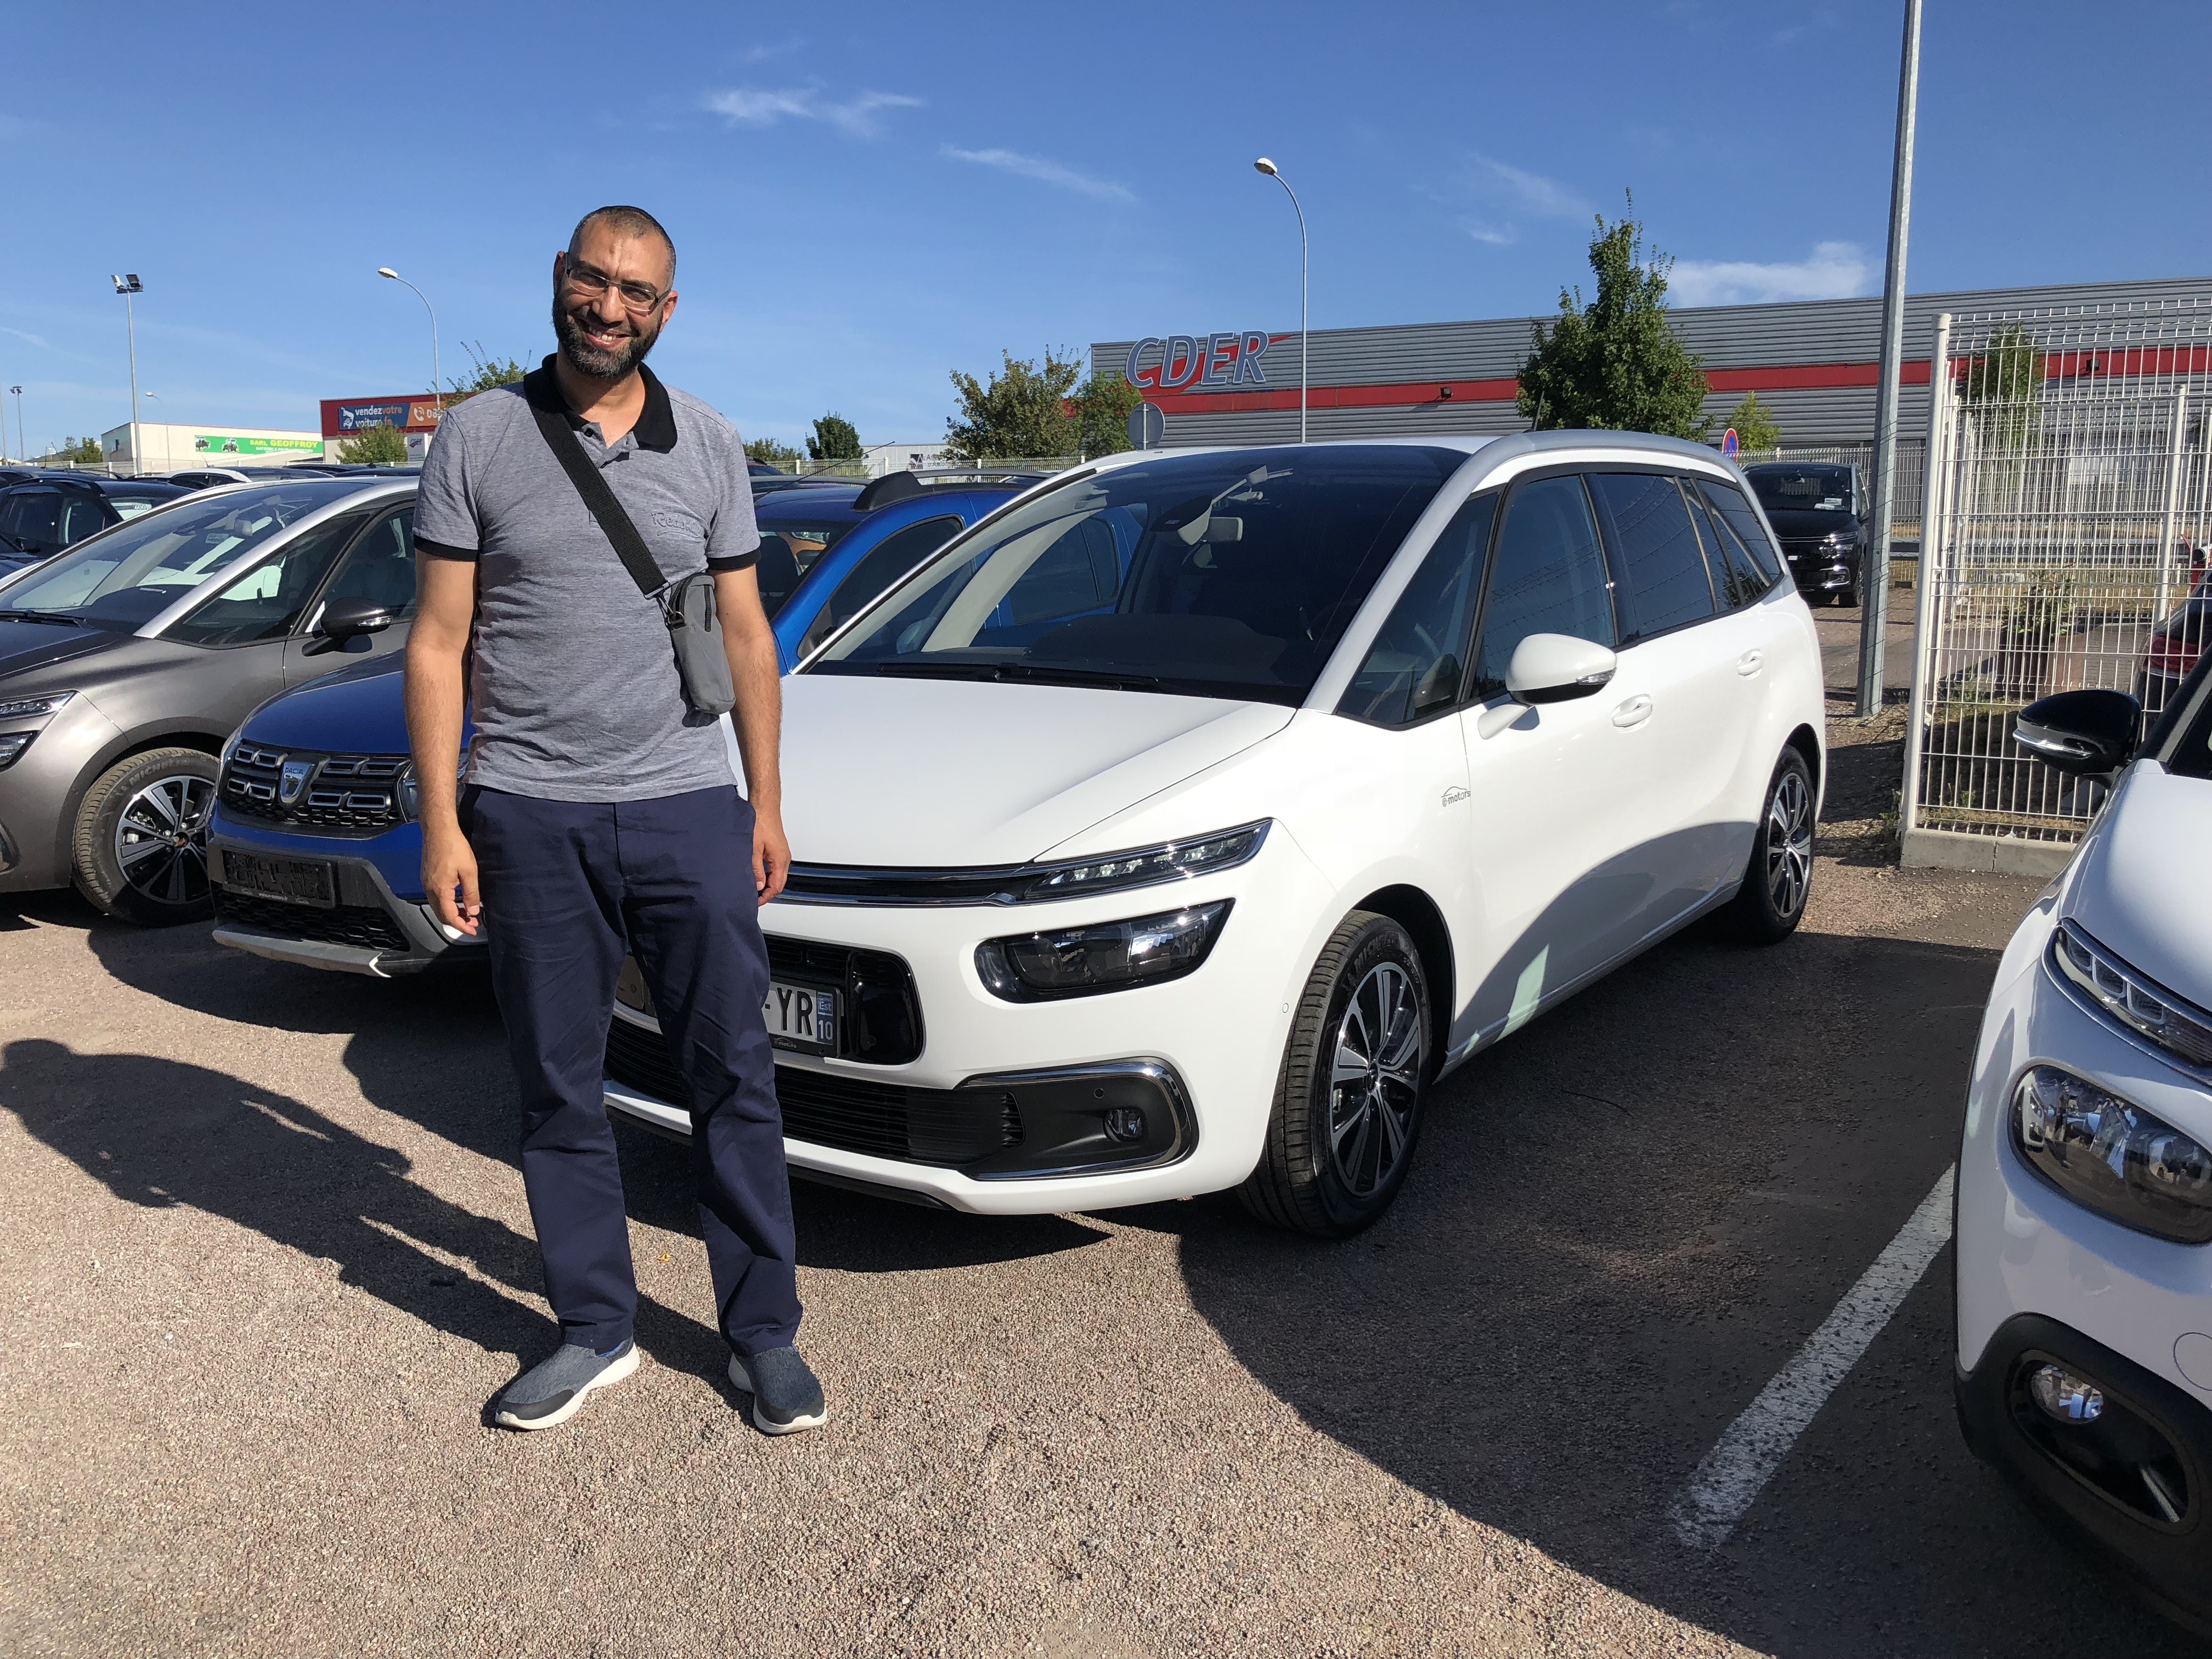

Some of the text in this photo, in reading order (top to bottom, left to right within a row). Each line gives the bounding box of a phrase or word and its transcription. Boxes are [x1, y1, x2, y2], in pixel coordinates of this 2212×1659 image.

[1126, 330, 1269, 388] CDER
[270, 439, 318, 448] GEOFFROY
[819, 1001, 832, 1011] Est
[819, 1019, 833, 1040] 10
